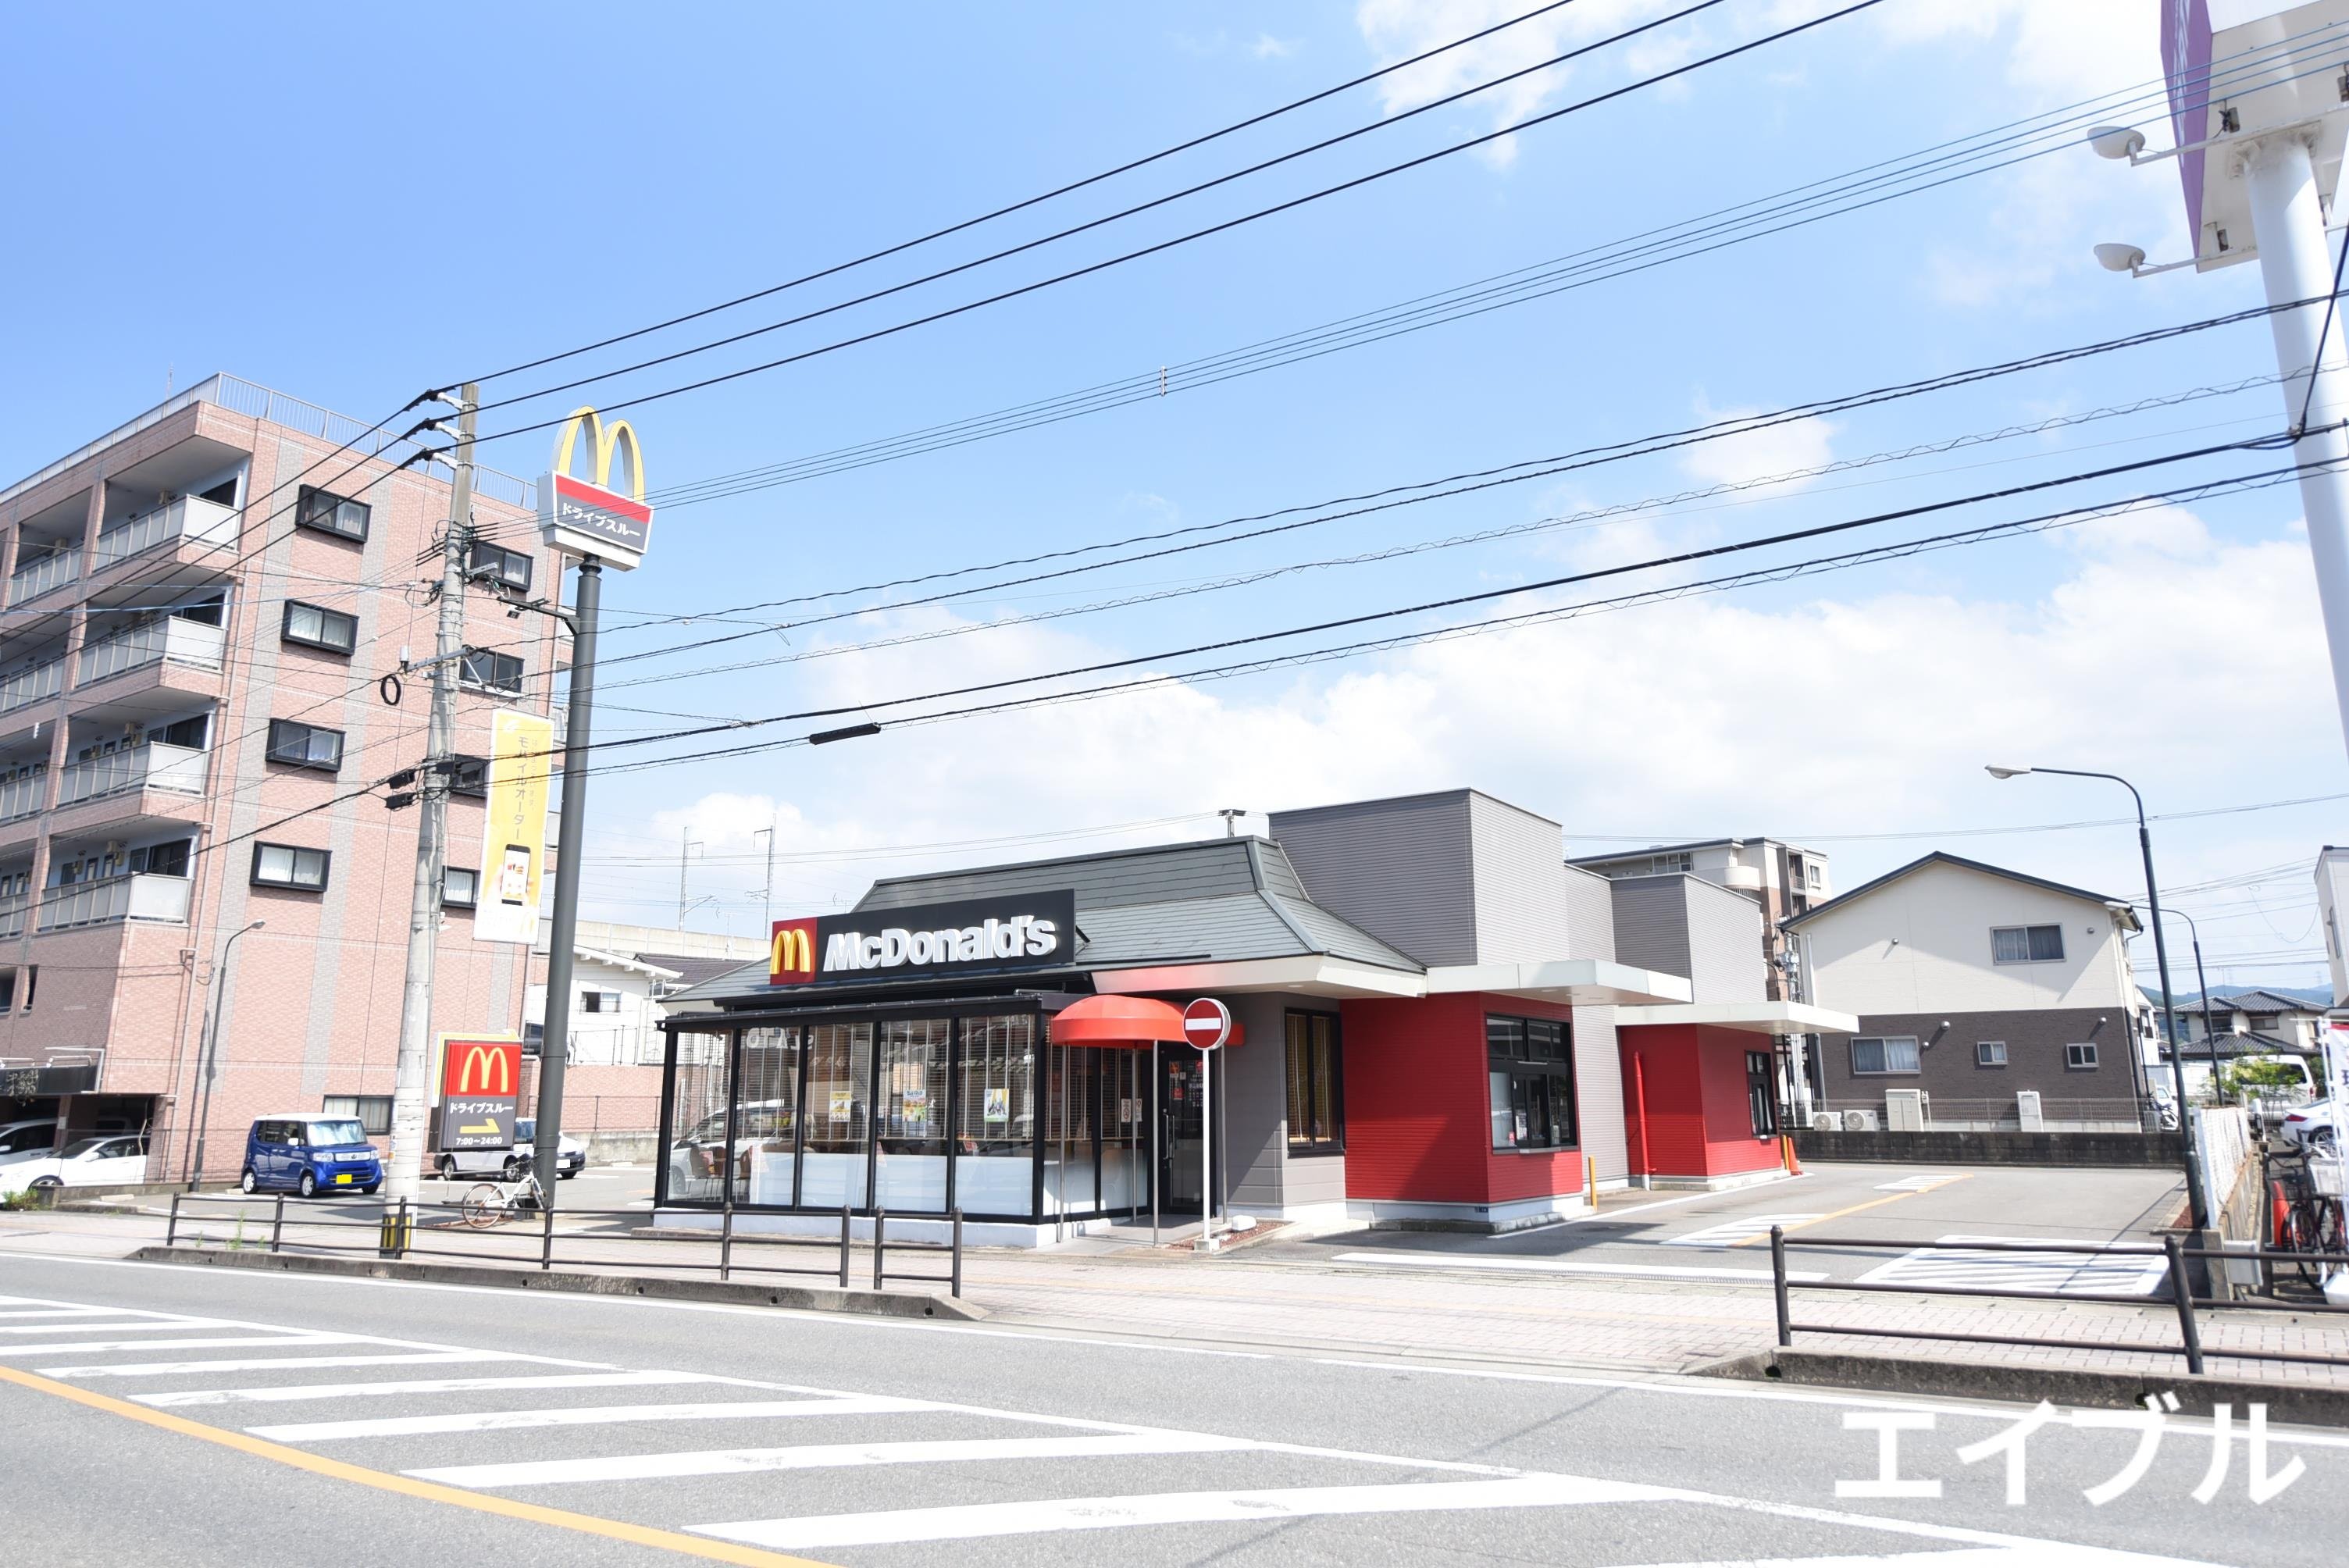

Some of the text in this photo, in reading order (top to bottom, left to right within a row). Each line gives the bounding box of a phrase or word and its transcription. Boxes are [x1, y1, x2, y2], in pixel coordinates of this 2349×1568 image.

[562, 502, 641, 536] ドライブスルー
[823, 914, 1057, 972] McDonald's
[450, 1102, 514, 1114] ドライブスルー
